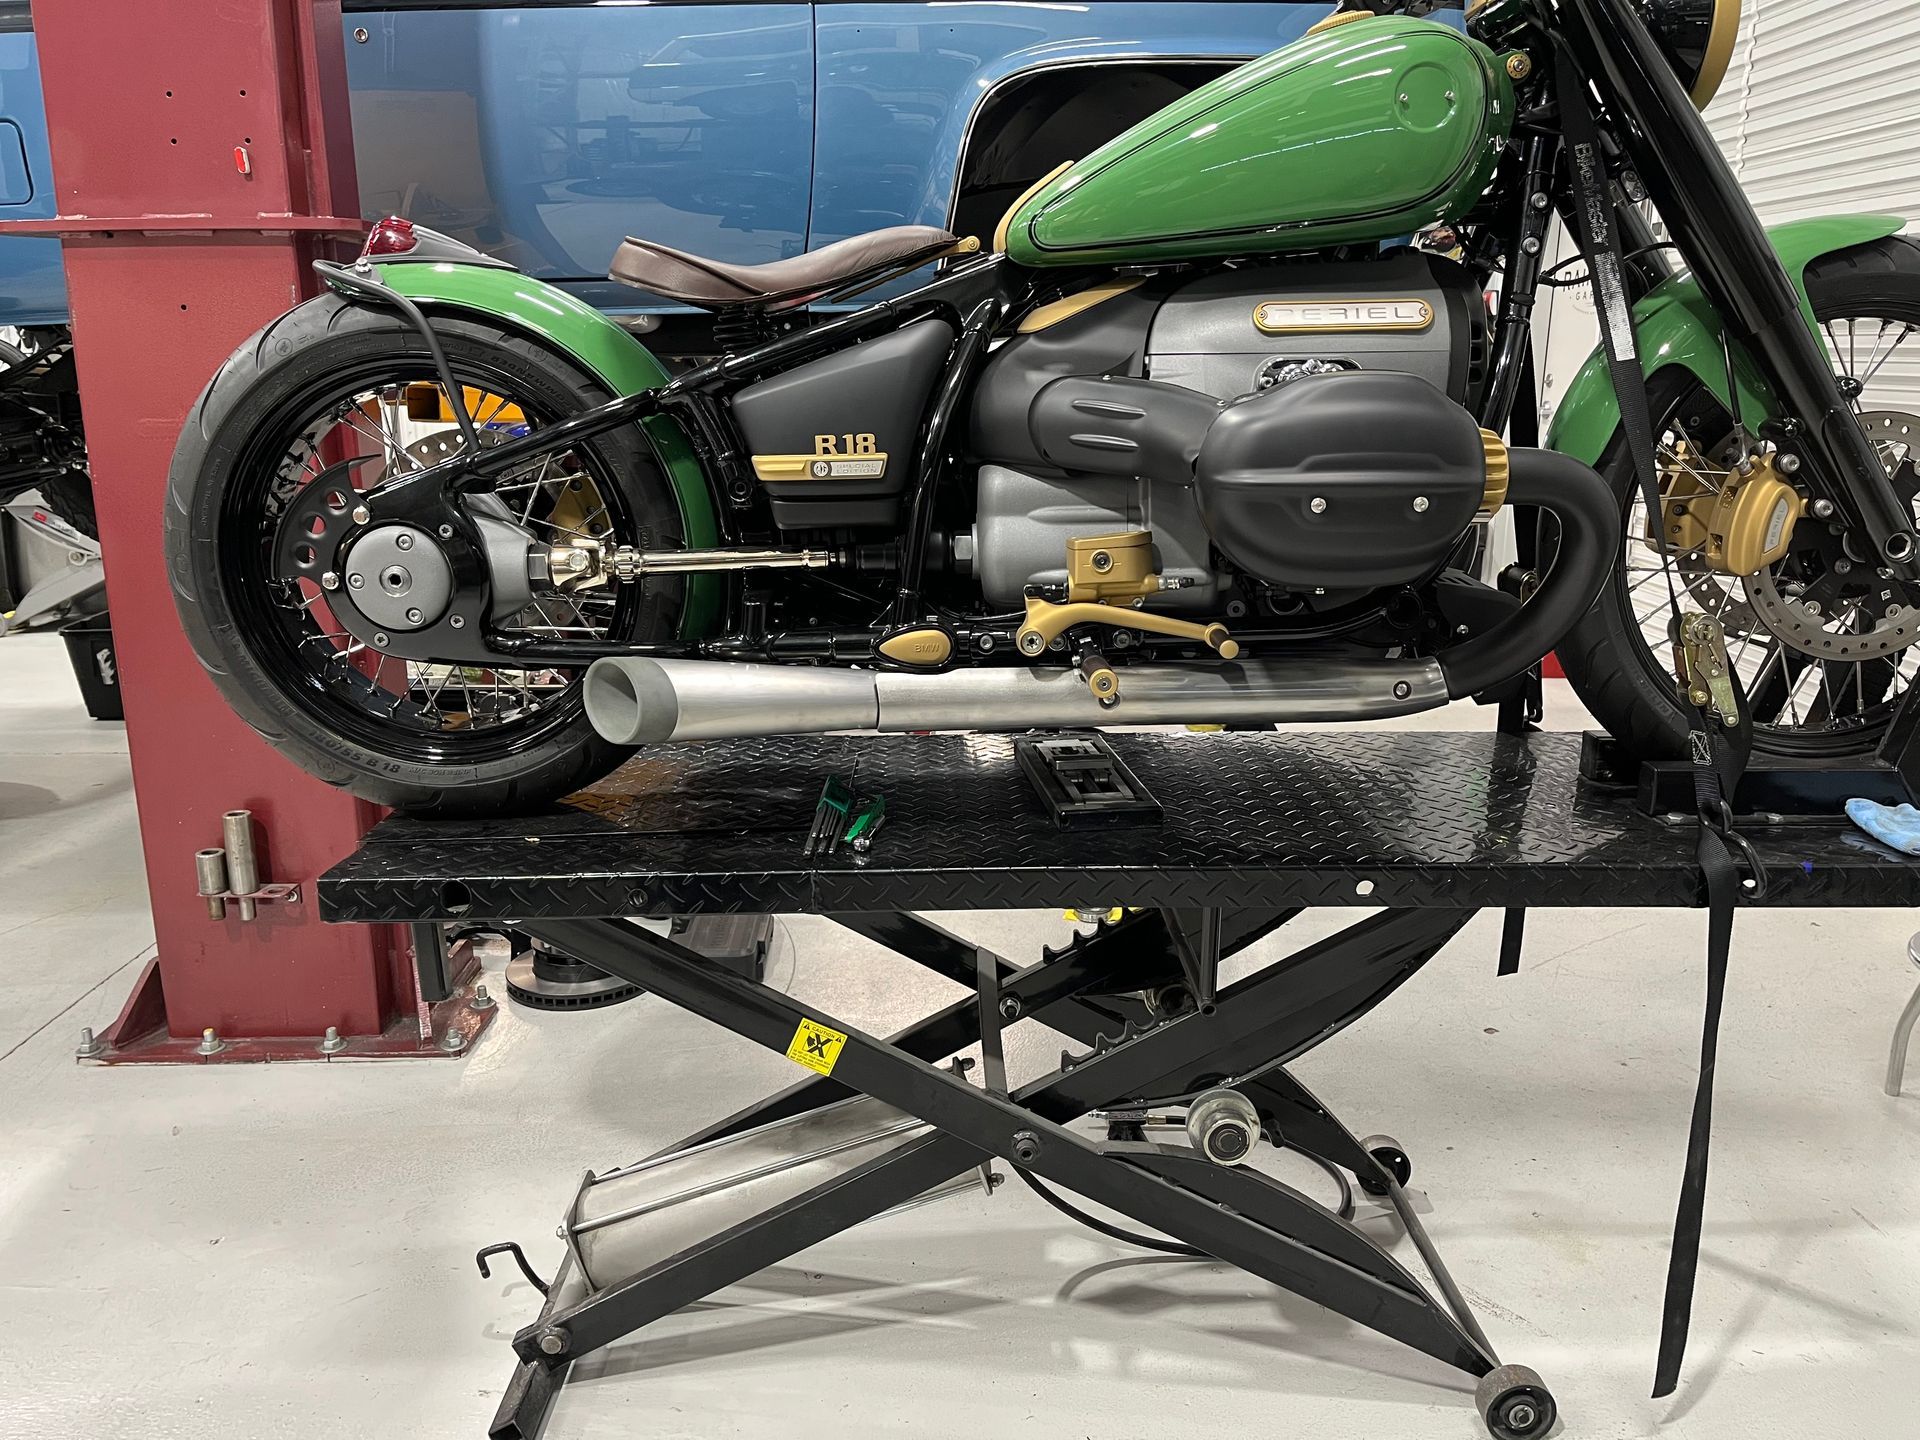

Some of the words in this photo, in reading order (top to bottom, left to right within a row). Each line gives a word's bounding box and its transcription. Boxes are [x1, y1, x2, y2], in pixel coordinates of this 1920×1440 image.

[815, 434, 838, 456] R
[842, 433, 877, 456] 18
[915, 643, 940, 653] BMW
[366, 759, 379, 767] B
[382, 762, 401, 773] 18
[811, 1026, 835, 1038] CAUTION
